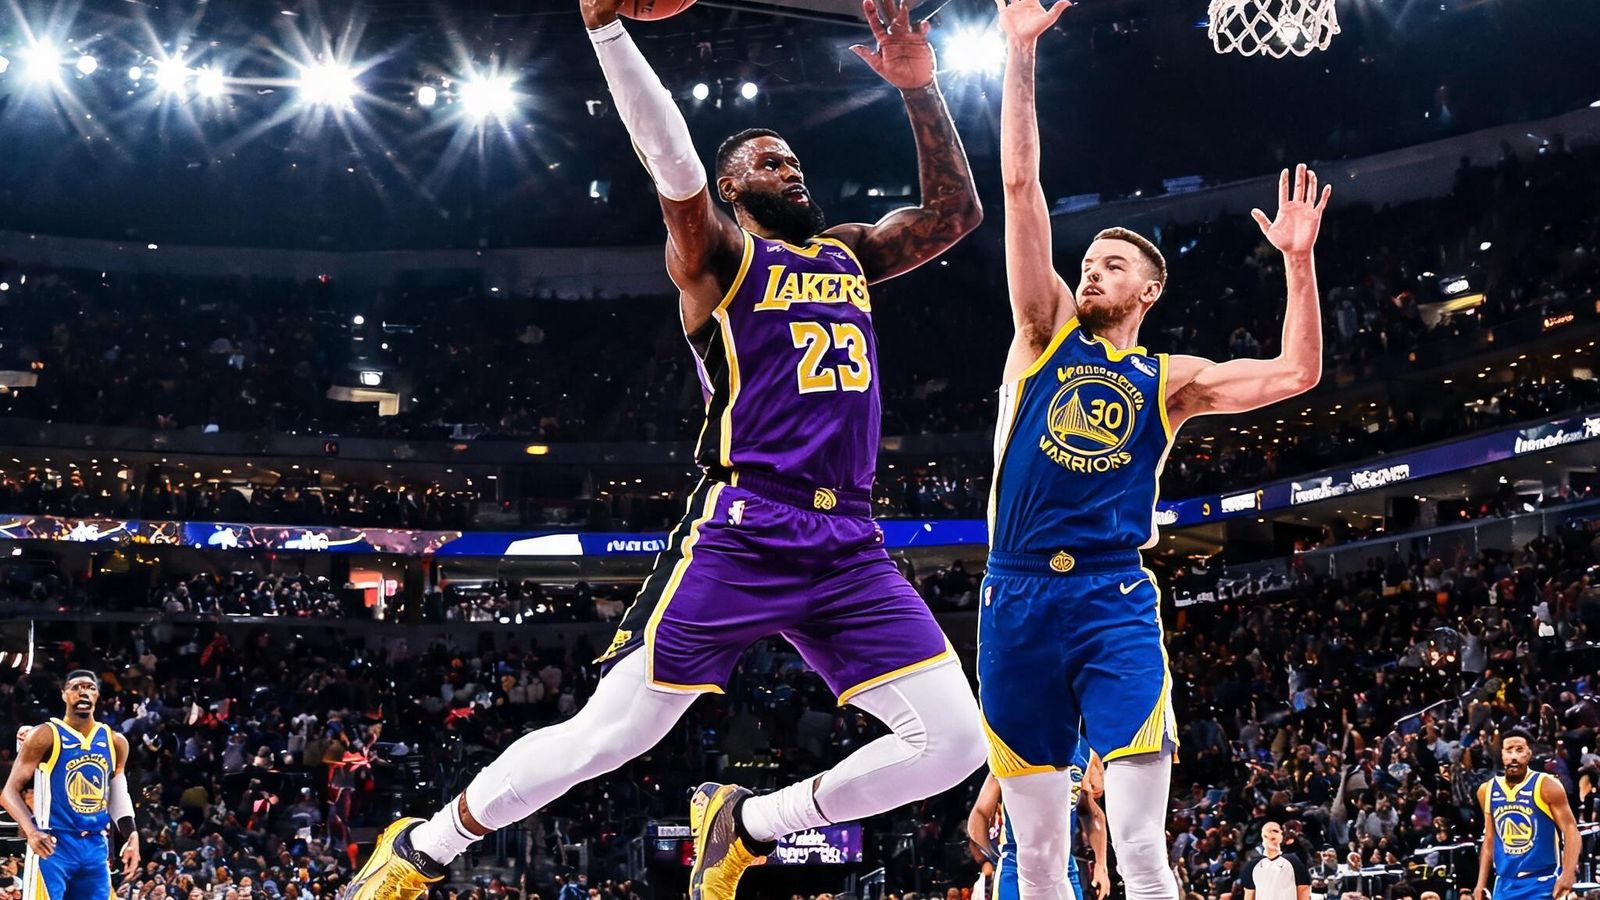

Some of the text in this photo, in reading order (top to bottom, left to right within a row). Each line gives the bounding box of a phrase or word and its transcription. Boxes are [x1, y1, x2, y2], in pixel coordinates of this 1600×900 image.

[753, 265, 872, 312] LAKERS
[789, 321, 872, 394] 23
[1088, 399, 1124, 430] 30
[1039, 434, 1132, 473] WARRIORS
